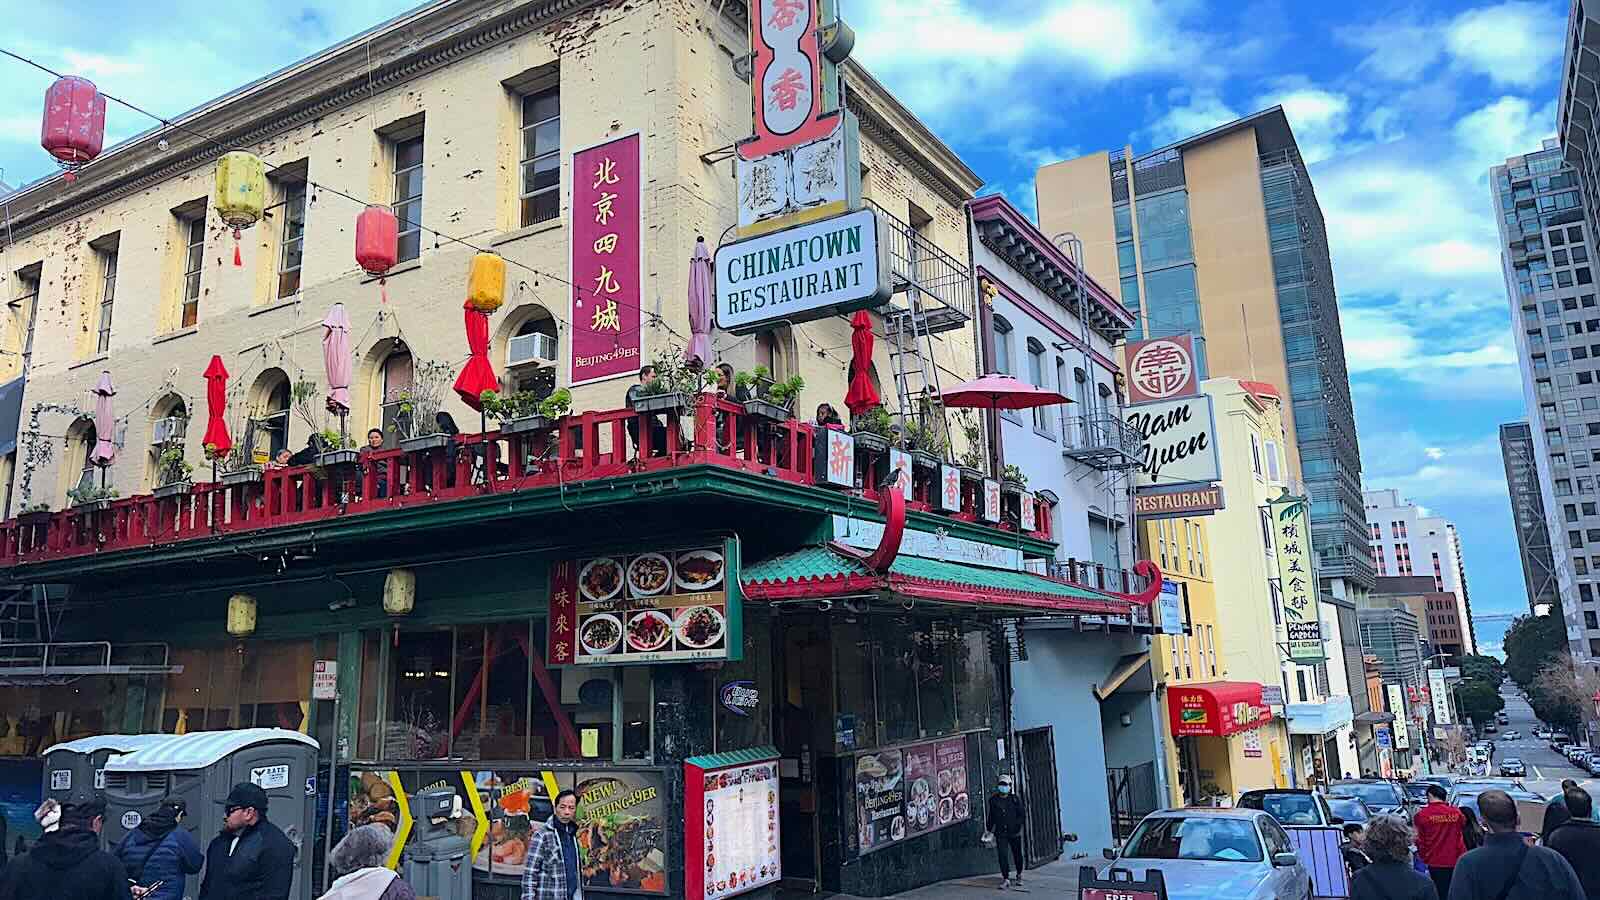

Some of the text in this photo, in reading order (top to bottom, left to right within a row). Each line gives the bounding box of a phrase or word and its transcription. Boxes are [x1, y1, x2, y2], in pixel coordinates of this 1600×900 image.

[590, 157, 621, 333] 北京四九城
[727, 225, 863, 285] CHINATOWN
[727, 262, 864, 316] RESTAURANT
[1127, 404, 1192, 441] Nam
[831, 435, 851, 482] 新
[1138, 431, 1209, 483] Yuen
[1135, 490, 1219, 512] RESTAURANT
[554, 560, 571, 662] 川味來客
[1289, 622, 1318, 631] PENANG
[1289, 631, 1319, 640] GARDEN
[501, 777, 529, 797] FRESH
[583, 781, 617, 804] NEW!
